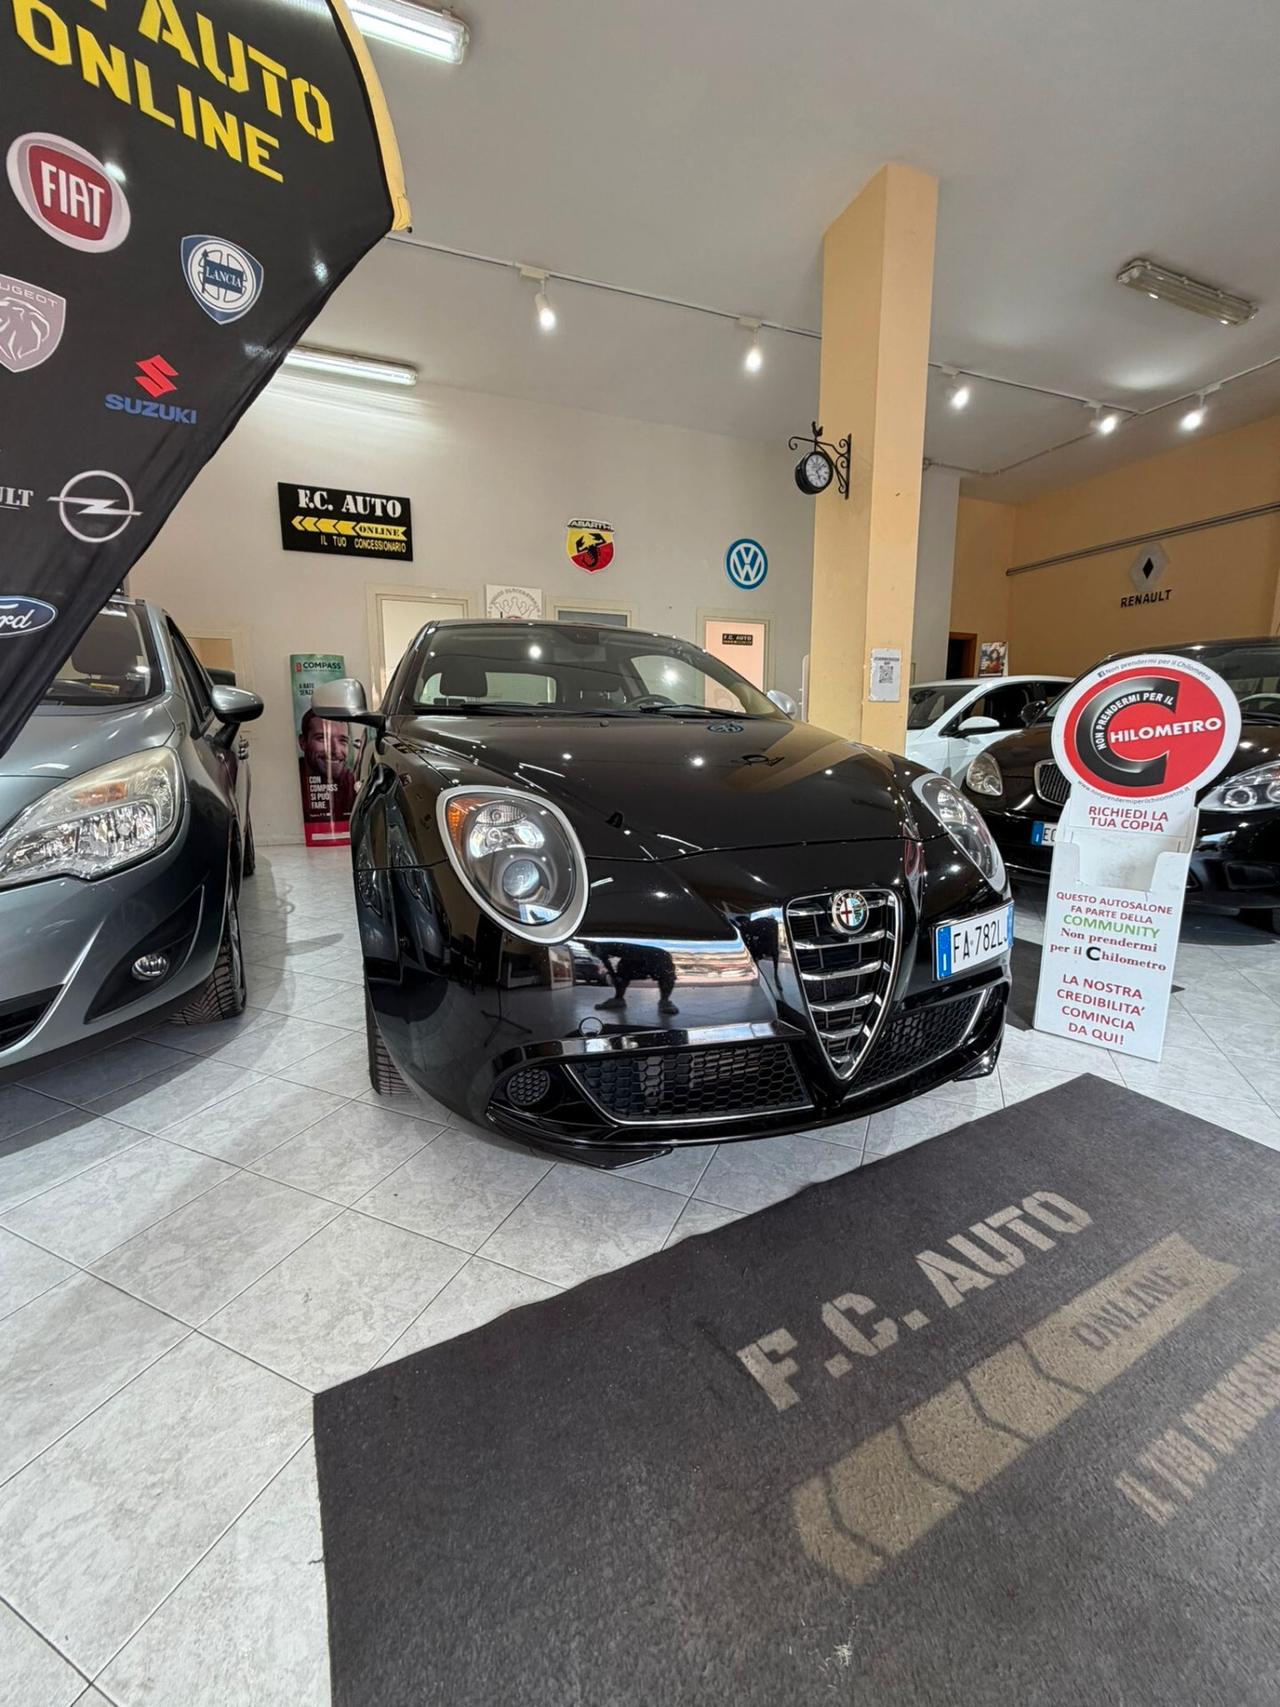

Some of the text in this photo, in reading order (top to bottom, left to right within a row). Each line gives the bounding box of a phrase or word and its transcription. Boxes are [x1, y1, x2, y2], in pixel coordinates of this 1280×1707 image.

[138, 0, 334, 143] AUTO
[11, 0, 284, 183] ONLINE
[41, 161, 104, 227] FIAT
[206, 265, 244, 288] LANCIA
[105, 394, 198, 425] SUZUKI
[297, 488, 402, 518] F.C. AUTO
[359, 526, 401, 537] ONLINE
[570, 520, 615, 531] ABARTH
[320, 534, 407, 553] IL TUO CONCESSIONARIO
[1120, 589, 1173, 608] RENAULT
[303, 661, 342, 670] COMPASS
[1121, 658, 1157, 669] prendermi
[1095, 692, 1174, 751] NON PRENDERMI PER IL
[310, 784, 338, 793] COMPASS
[1088, 805, 1169, 822] RICHIEDI LA
[1089, 816, 1164, 832] TUA COPIA
[1056, 891, 1173, 915] QUESTO AUTOSALONE
[1070, 905, 1153, 924] FA PARTE DELLA
[1063, 914, 1160, 939] COMMUNITY
[1060, 927, 1158, 953] Non prendermi
[1050, 944, 1167, 972] per il Chilometro
[1062, 974, 1143, 999] LA NOSTRA
[1056, 988, 1145, 1016] CREDIBILITA'
[1061, 1005, 1135, 1031] COMINCIA
[1068, 1022, 1124, 1045] DA QUI!
[737, 1190, 1093, 1412] F.C. AUTO
